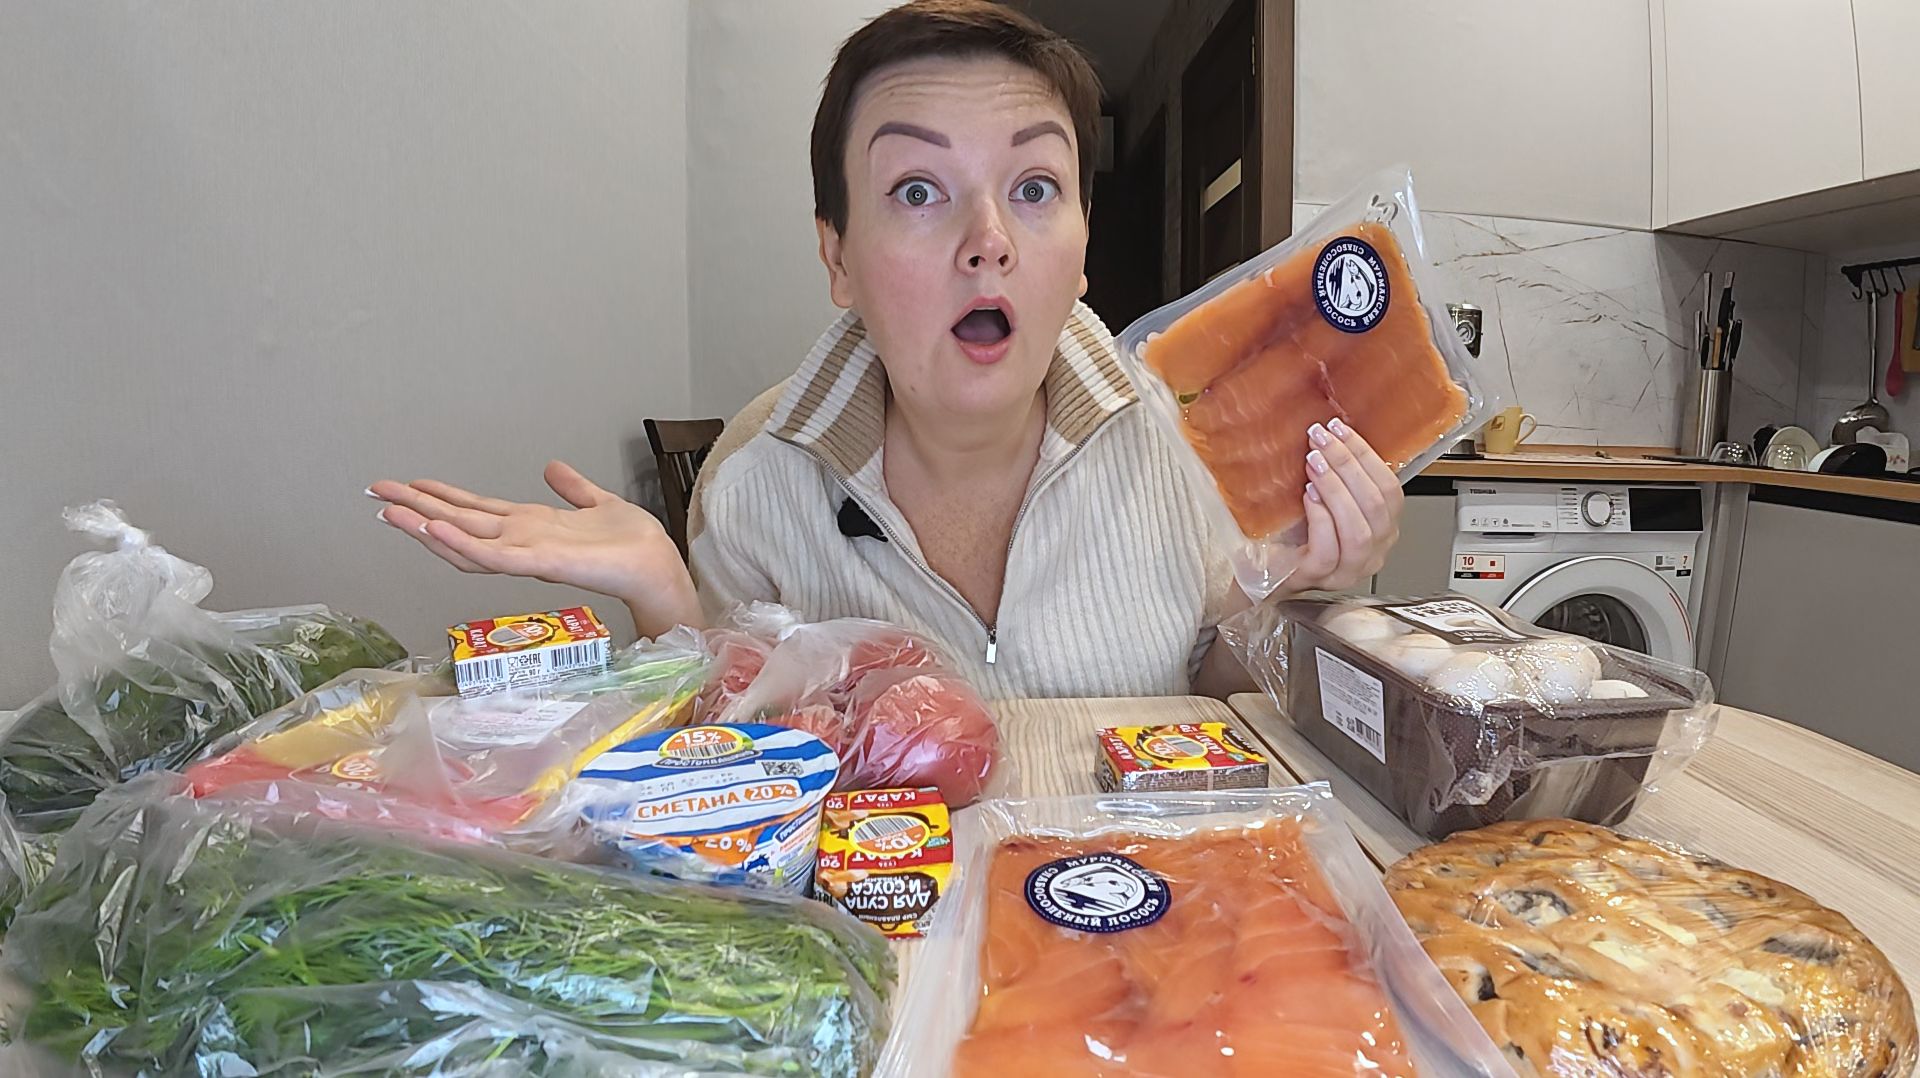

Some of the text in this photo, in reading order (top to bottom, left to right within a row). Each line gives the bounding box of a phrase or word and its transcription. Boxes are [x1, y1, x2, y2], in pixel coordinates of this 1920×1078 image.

[1317, 243, 1365, 327] СЛАБОСОЛЕНЫЙ ЛОСОСЬ
[1362, 256, 1386, 326] МУРМАНСКИЙ
[1462, 556, 1474, 566] 10
[563, 614, 584, 633] КАРАТ
[469, 628, 487, 648] КАРАТ
[674, 730, 722, 745] -15%
[637, 791, 741, 819] СМЕТАНА
[826, 800, 844, 809] 90
[854, 791, 915, 803] КАРАТ
[874, 834, 922, 851] -10%
[820, 858, 840, 868] 90
[1066, 856, 1162, 893] МУРМАНСКИЙ
[851, 878, 921, 895] И СОУСА
[845, 895, 889, 910] СУПА
[893, 890, 931, 908] ДЛЯ
[1033, 867, 1159, 927] СЛАБОСОЛЕНЫЙ ЛОСОСЬ
